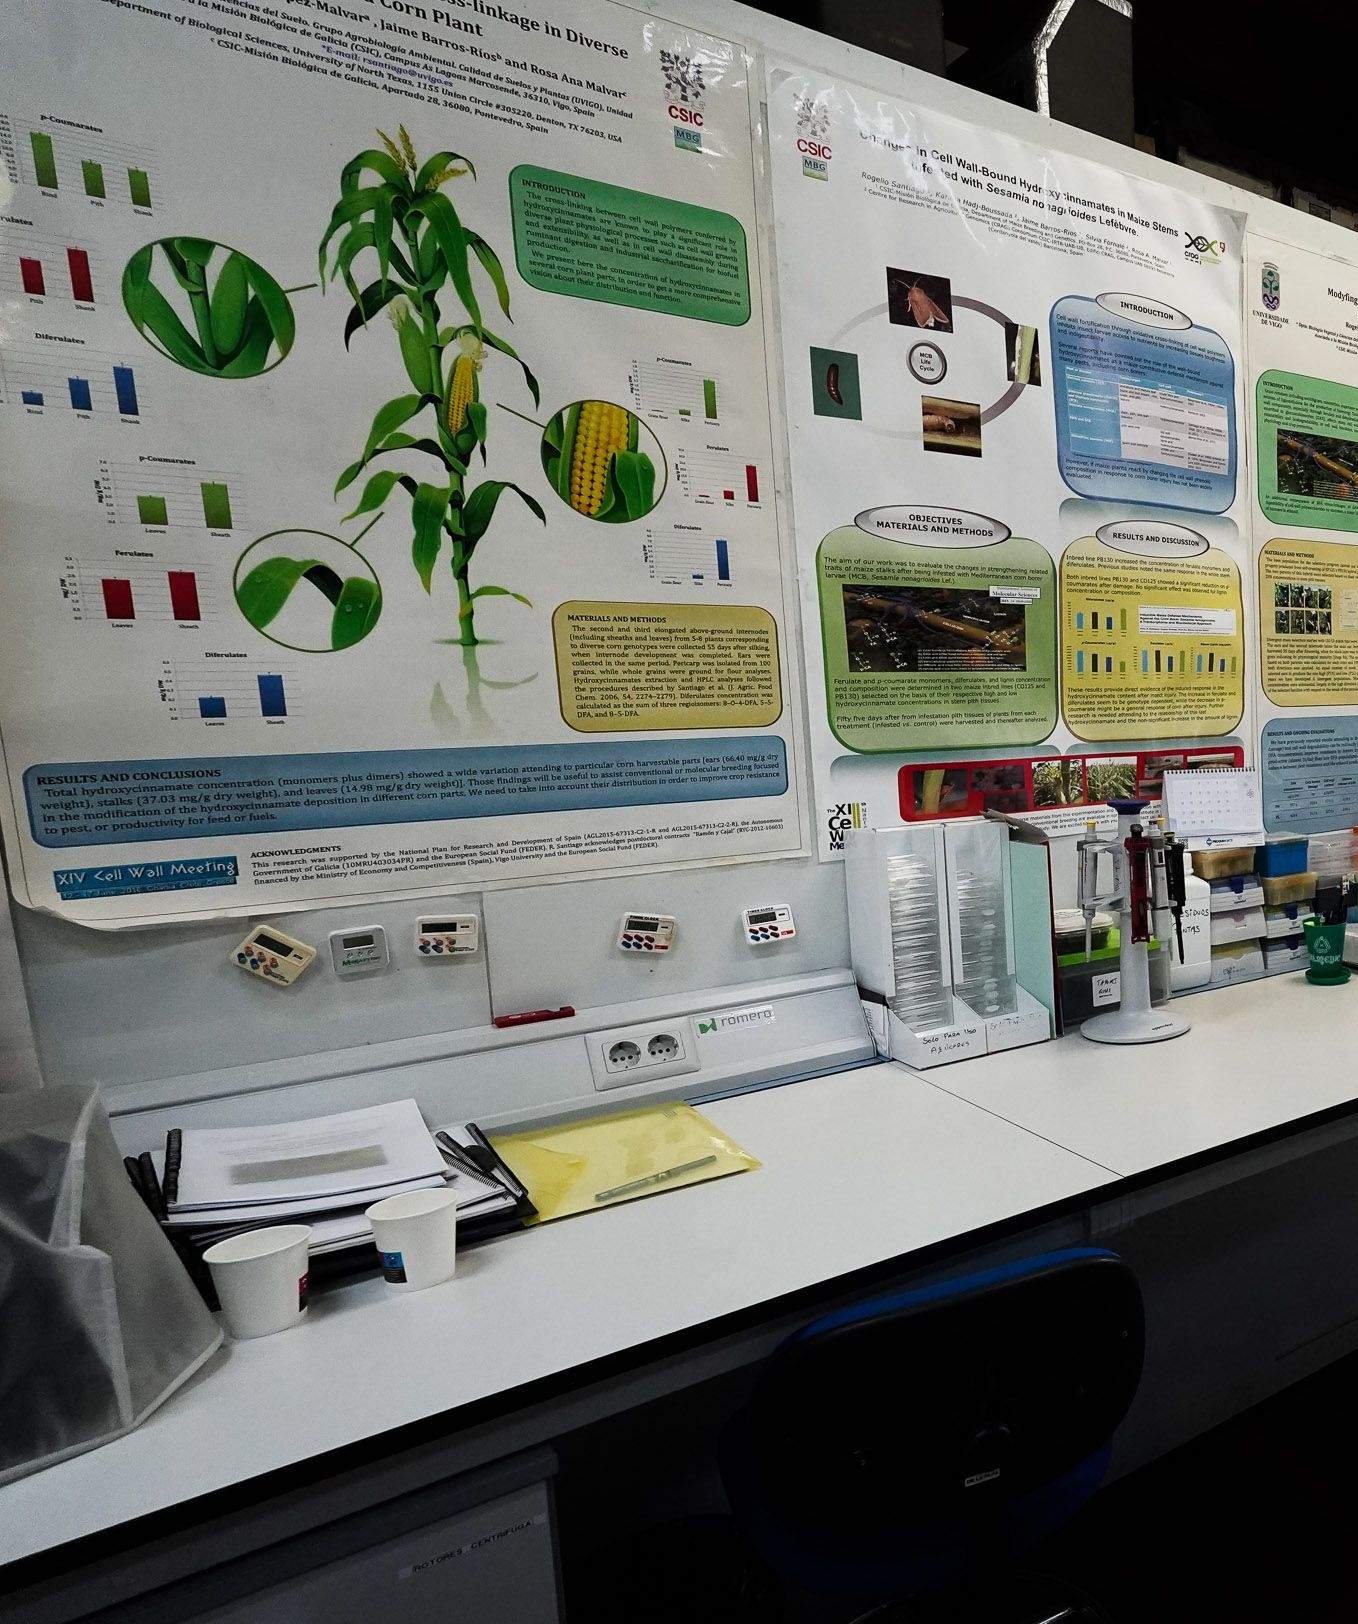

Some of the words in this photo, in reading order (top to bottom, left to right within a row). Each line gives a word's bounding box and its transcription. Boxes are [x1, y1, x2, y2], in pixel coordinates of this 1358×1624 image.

[380, 0, 427, 19] Corn
[432, 9, 483, 38] Plant
[544, 20, 560, 38] in
[565, 27, 628, 61] Diverse
[380, 18, 417, 39] Jaime
[504, 55, 527, 70] and
[530, 63, 557, 79] Rosa
[561, 73, 582, 87] Ana
[262, 6, 277, 17] del
[312, 21, 341, 36] Grupo
[344, 30, 405, 55] Agrobiología
[458, 63, 490, 78] Calidad
[493, 73, 502, 82] de
[504, 76, 530, 90] Suelos
[539, 86, 569, 101] Plantas
[606, 105, 632, 119] Unidad
[174, 14, 184, 25] of
[188, 18, 241, 40] Biological
[244, 33, 290, 52] Sciences,
[293, 47, 342, 68] University
[345, 61, 355, 71] of
[357, 64, 383, 78] North
[386, 72, 414, 87] Texas,
[417, 81, 438, 93] 1155
[441, 88, 466, 100] Union
[469, 96, 493, 108] Circle
[495, 103, 535, 120] #305220,
[536, 114, 566, 128] Denton,
[568, 122, 578, 131] TX
[580, 126, 606, 139] 76203,
[607, 133, 621, 143] USA
[40, 114, 103, 133] p-Coumarates
[668, 105, 703, 126] CSIC
[676, 129, 700, 143] MBG
[796, 138, 832, 160] CSIC
[804, 159, 826, 171] MBG
[522, 179, 586, 199] INTRODUCTION
[931, 149, 952, 164] Cell
[955, 157, 1016, 184] Wall-Bound
[1019, 177, 1114, 215] Hydrxyinnamates
[1117, 208, 1125, 218] in
[1127, 211, 1149, 227] Maize
[1152, 220, 1178, 238] Stems
[961, 174, 982, 188] with
[986, 182, 1029, 203] Sesamia
[1, 216, 33, 226] rulates
[1327, 287, 1357, 305] Modyfing
[1120, 301, 1173, 320] INTRODUCTION
[139, 455, 196, 465] p-Coumarates
[876, 521, 928, 531] MATERIALS
[931, 525, 949, 533] AND
[952, 527, 993, 536] METHODS
[908, 514, 962, 524] OBJECTIVES
[1112, 533, 1143, 541] RESULTS
[1161, 537, 1199, 546] DISCUSSION
[115, 549, 154, 557] Ferulates
[654, 627, 685, 635] elongated
[690, 628, 732, 636] above-ground
[37, 774, 97, 785] RESULTS
[101, 772, 129, 781] AND
[132, 769, 221, 780] CONCLUSIONS
[44, 787, 76, 797] Total
[82, 782, 193, 795] hydroxycinnamate
[197, 779, 273, 789] concentration
[342, 774, 362, 783] plus
[407, 770, 442, 778] showed
[480, 766, 518, 774] variation
[521, 764, 560, 774] attending
[575, 761, 613, 771] particular
[250, 845, 340, 858] ACKNOWLEDGMENTS
[59, 873, 84, 884] XIV
[94, 870, 121, 881] Cell
[128, 866, 163, 878] Wall
[170, 860, 234, 880] Meeting
[721, 1009, 772, 1026] romero
[412, 1548, 463, 1573] ROTORES
[470, 1520, 533, 1550] CENTRIFUGA
